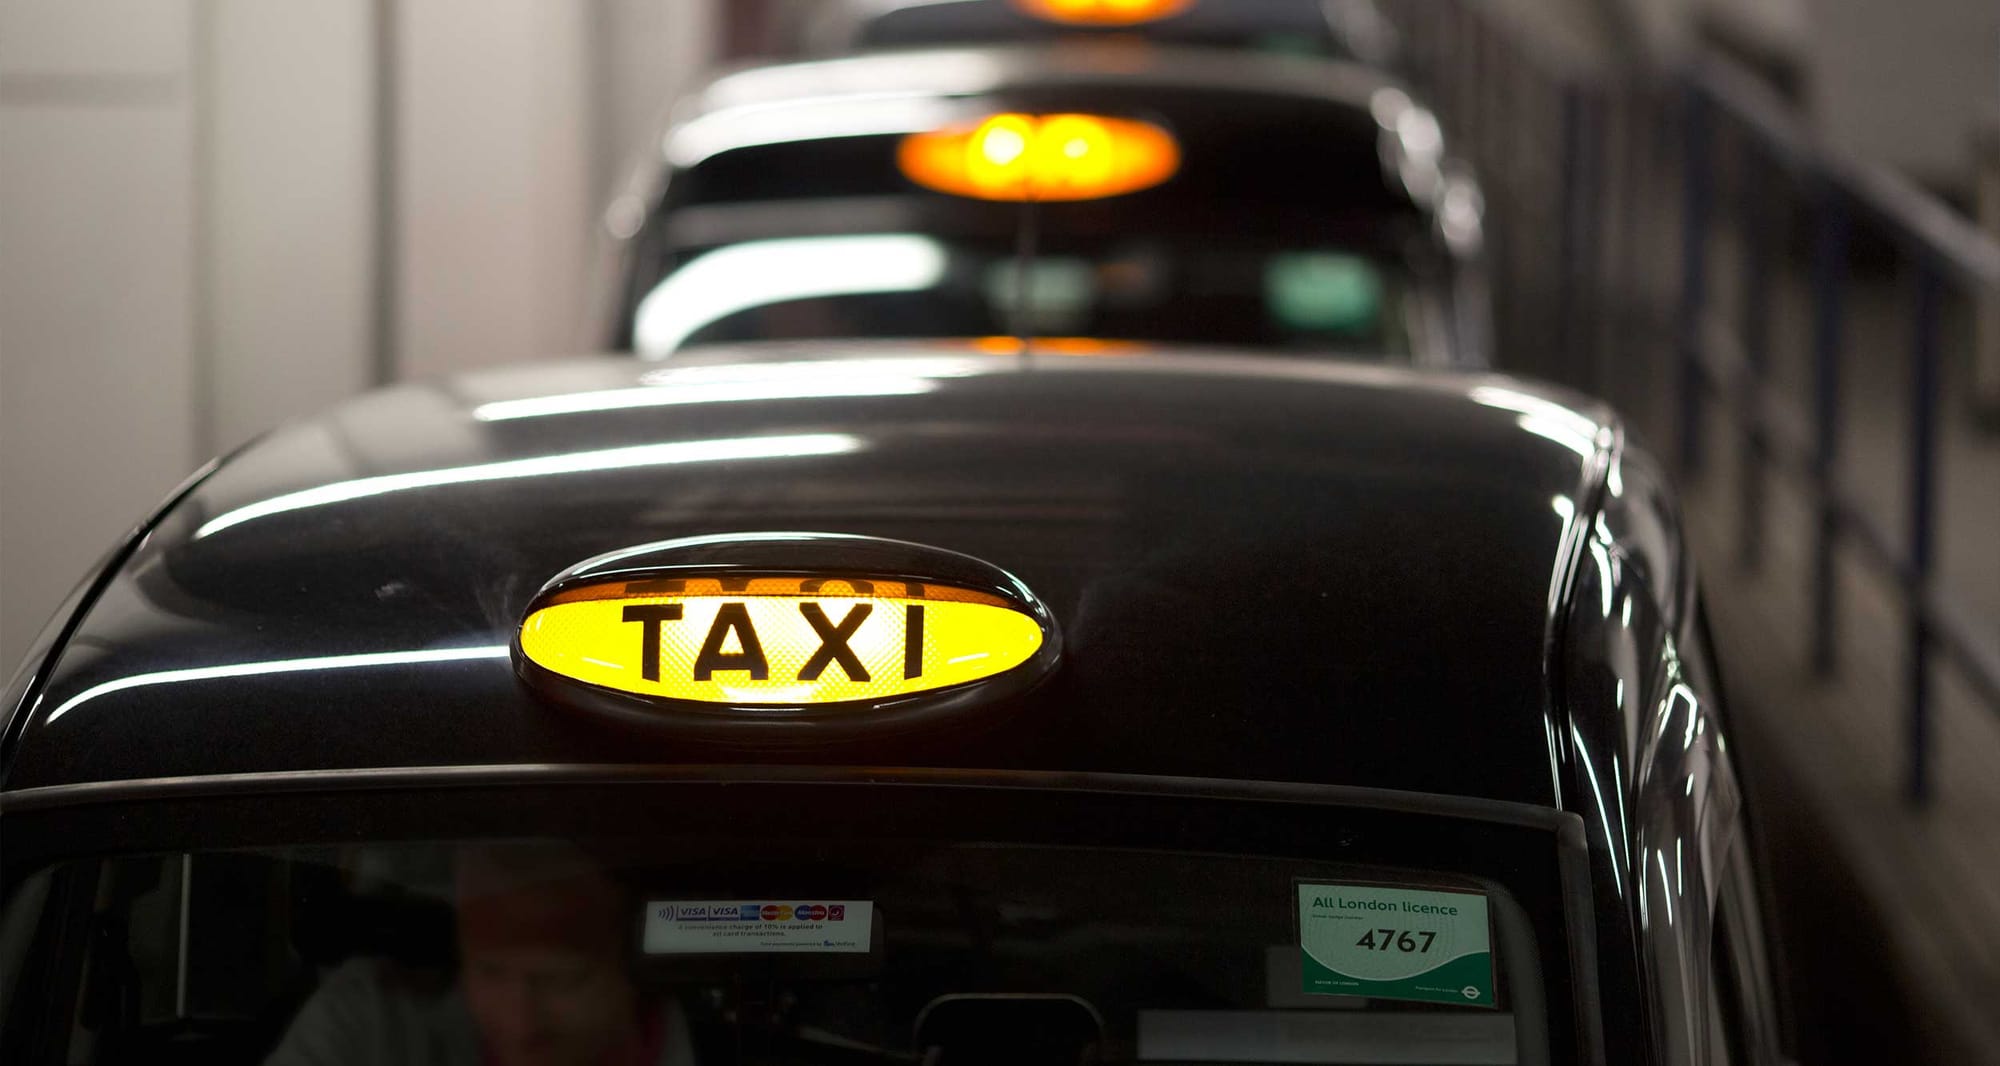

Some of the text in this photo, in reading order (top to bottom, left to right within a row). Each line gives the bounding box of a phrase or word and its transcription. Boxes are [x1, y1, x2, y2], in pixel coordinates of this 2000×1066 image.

[622, 602, 925, 683] TAXI
[681, 907, 706, 916] VISA
[713, 907, 738, 916] VISA
[1312, 896, 1459, 916] All London licence
[729, 923, 753, 931] charge
[788, 923, 814, 931] applied
[1356, 928, 1437, 953] 4767
